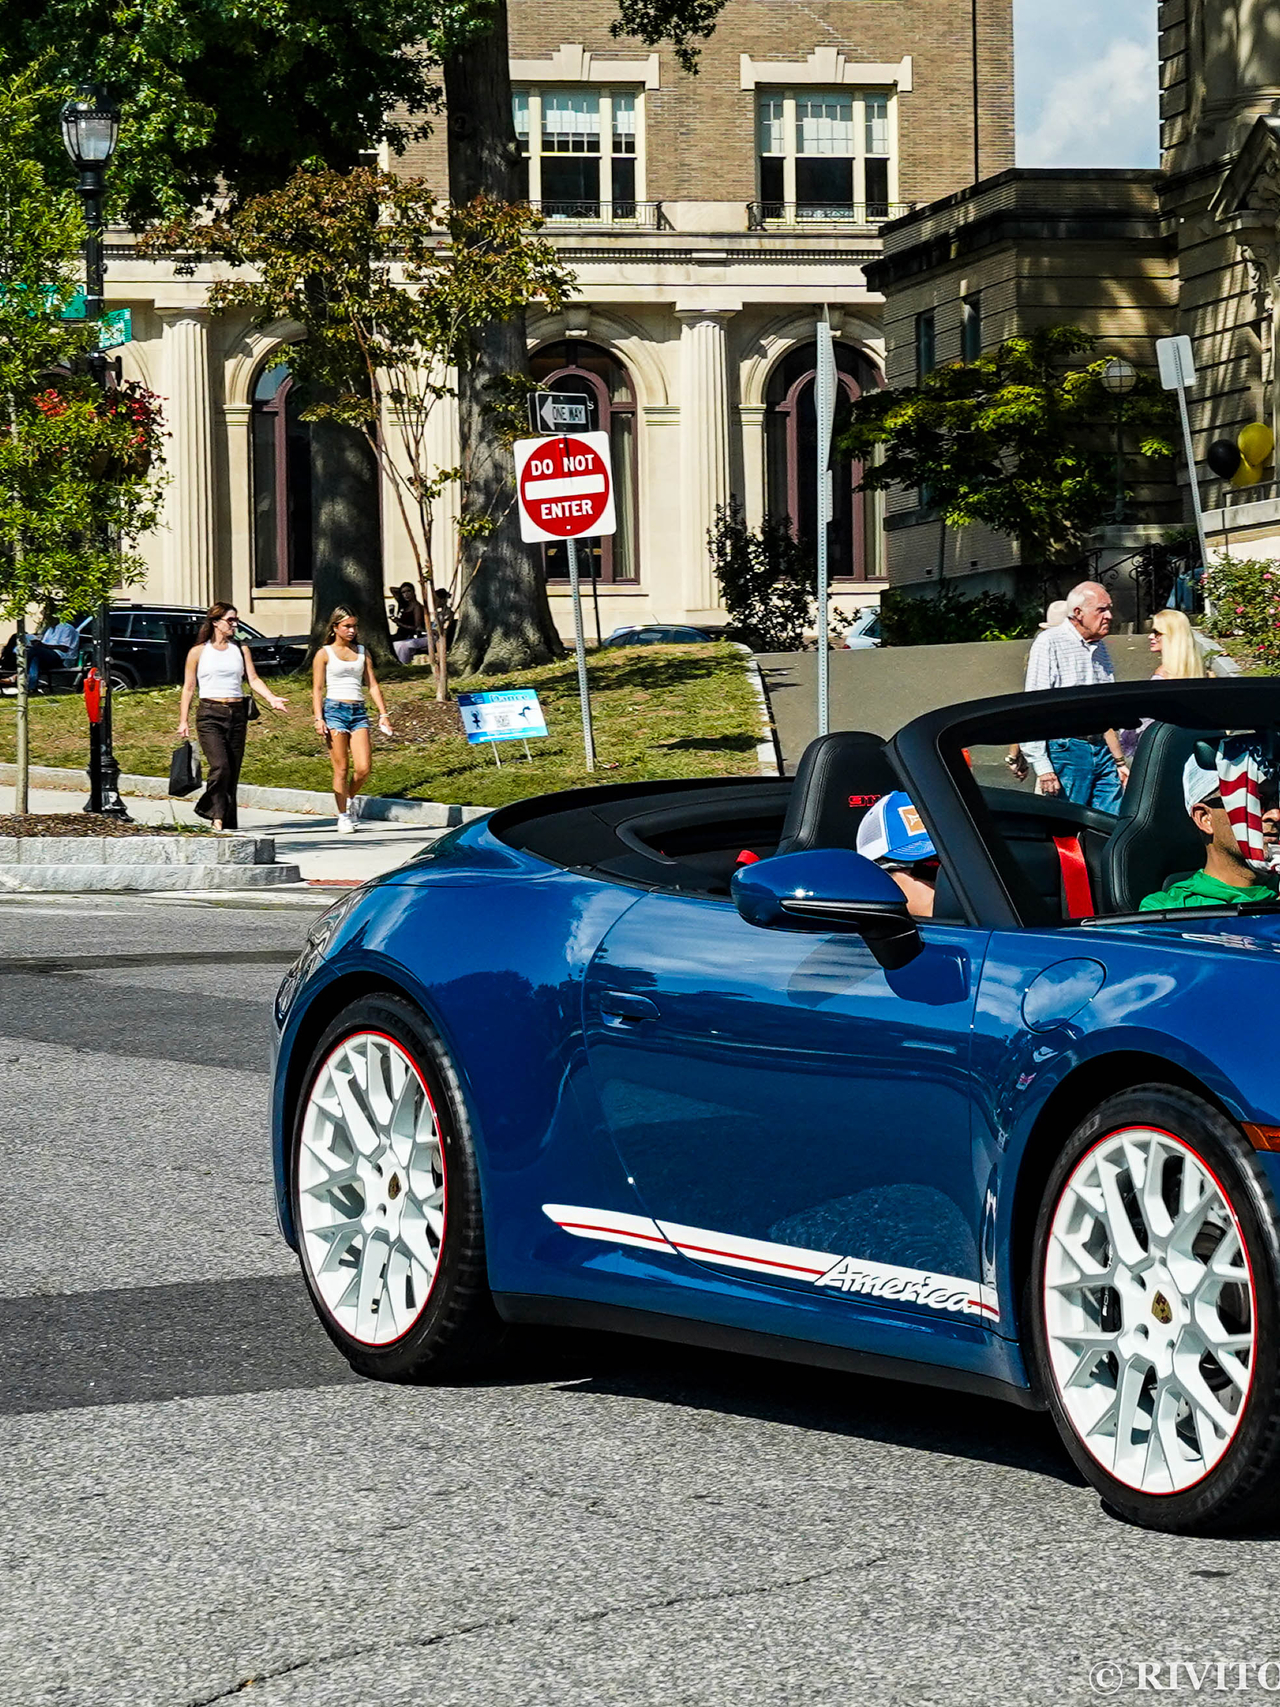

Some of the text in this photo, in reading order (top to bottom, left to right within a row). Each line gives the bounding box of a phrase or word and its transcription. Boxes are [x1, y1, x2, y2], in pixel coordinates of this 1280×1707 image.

[552, 405, 583, 421] ONE WAY
[530, 454, 595, 476] DO NOT
[540, 499, 594, 520] ENTER
[814, 1256, 977, 1314] America
